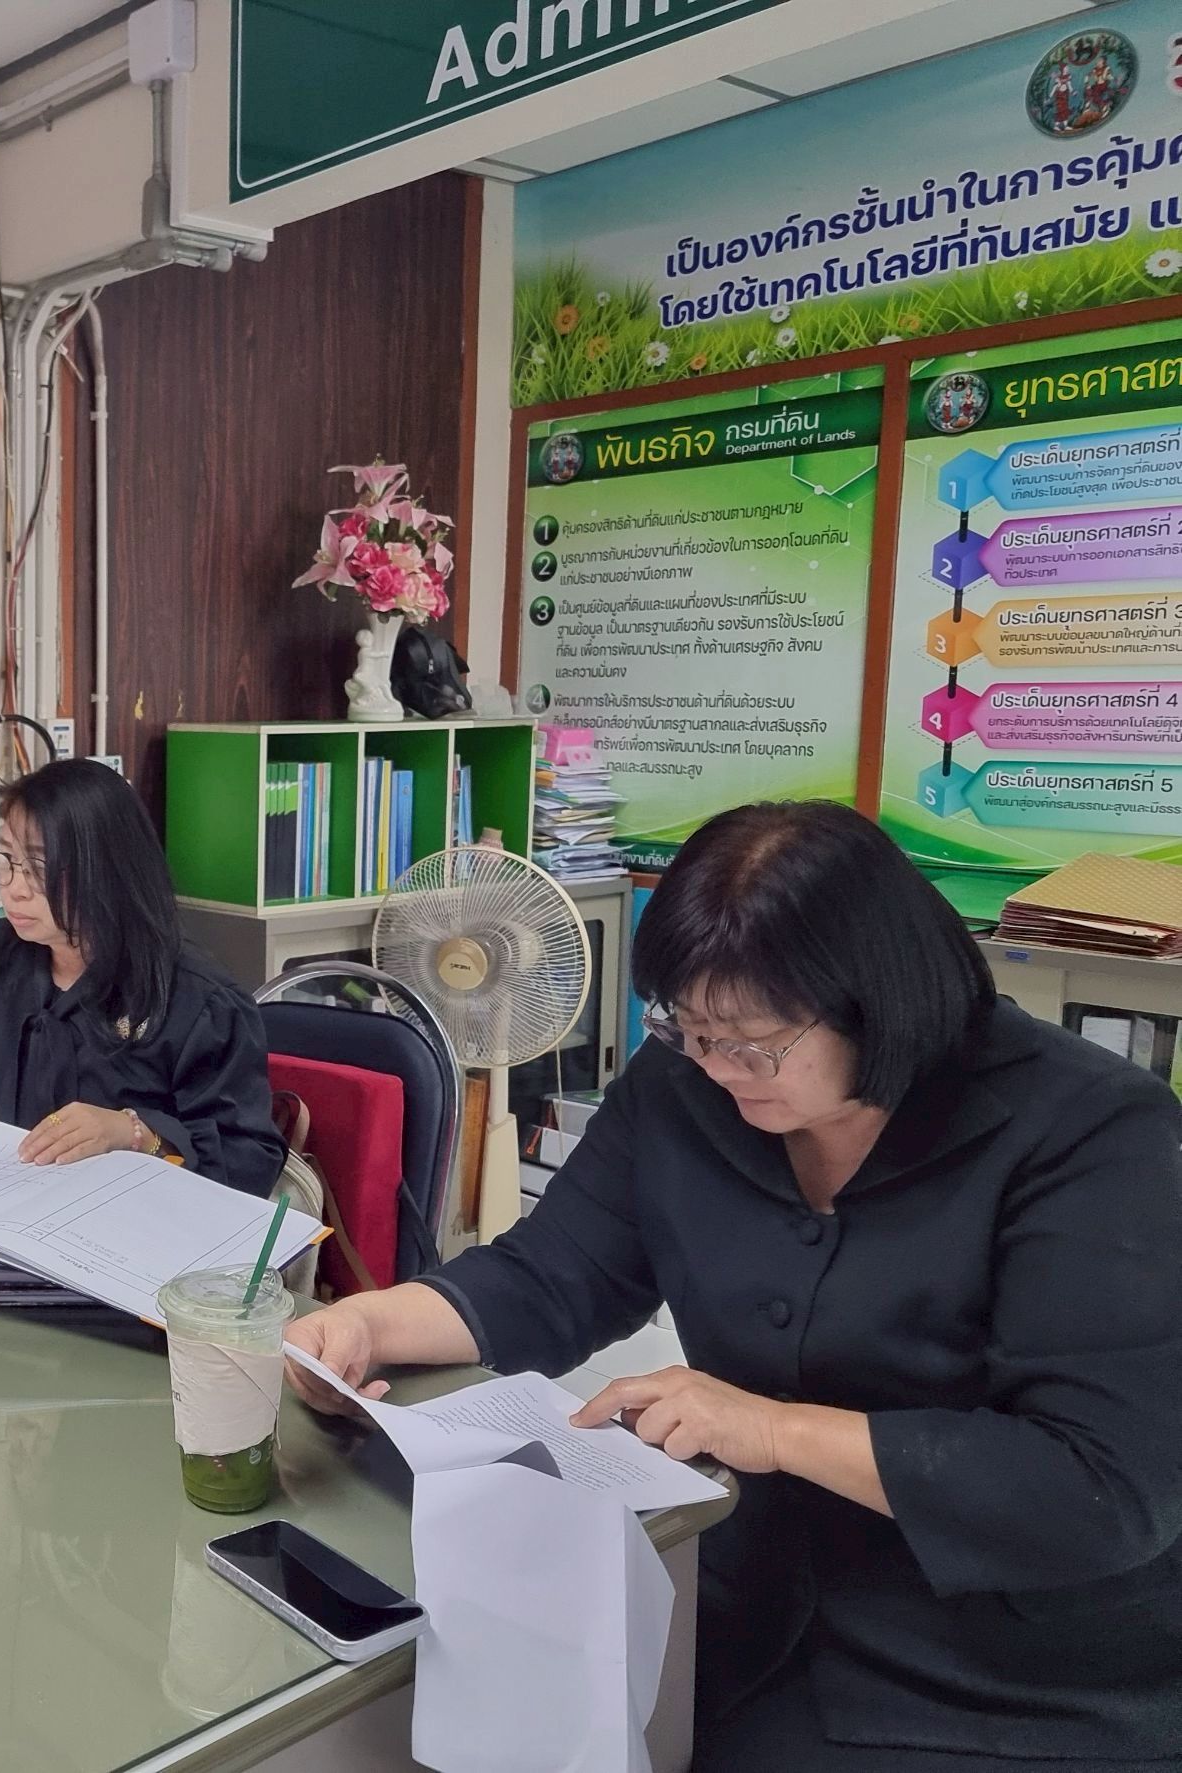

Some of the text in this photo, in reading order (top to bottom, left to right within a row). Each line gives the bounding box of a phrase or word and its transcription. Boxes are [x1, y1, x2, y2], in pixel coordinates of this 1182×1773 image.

[426, 0, 697, 104] Adm
[659, 203, 1131, 328] โดยใช้เทคโนโลยีที่ทันสมัย
[595, 405, 820, 470] พันธกิจ กรมที่ดิน
[725, 429, 856, 456] Department of Lands
[948, 481, 957, 500] 1
[539, 557, 551, 576] 2
[939, 543, 1182, 579] 2 พัฒนาระบบการออกเอกสารสิทธิ
[536, 602, 549, 621] 3
[934, 622, 1182, 654] 3 พัฒนาระบบข้อมูลขนาดใหญ่ด้านที่
[1165, 693, 1178, 708] 4
[928, 712, 1182, 730] 4 ยกระดับการบริการด้วยเทคโนโลยีดิจิ
[925, 785, 937, 806] 5
[1160, 778, 1174, 793] 5
